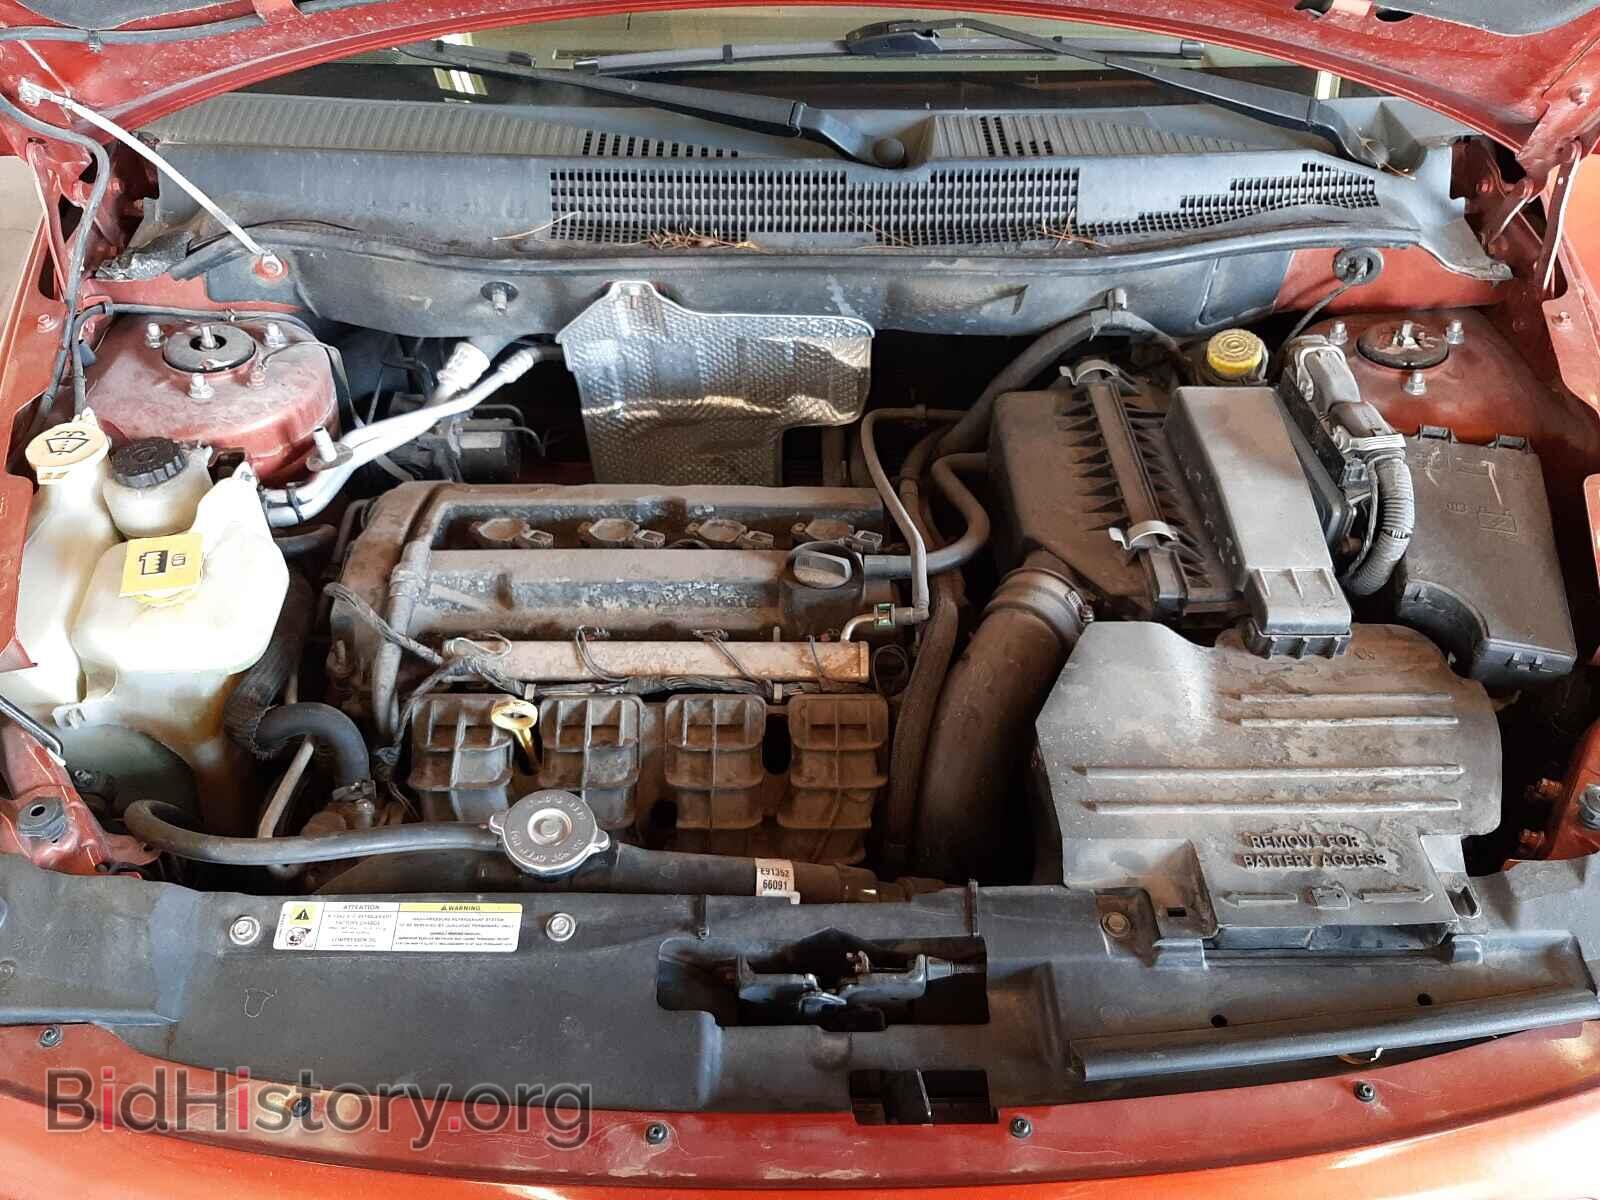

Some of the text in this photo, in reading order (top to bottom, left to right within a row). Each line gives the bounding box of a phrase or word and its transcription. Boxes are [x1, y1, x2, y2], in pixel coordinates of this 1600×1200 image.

[1325, 834, 1361, 848] FOR
[1243, 853, 1387, 868] BATTERY ACCESS
[762, 879, 788, 890] 66091
